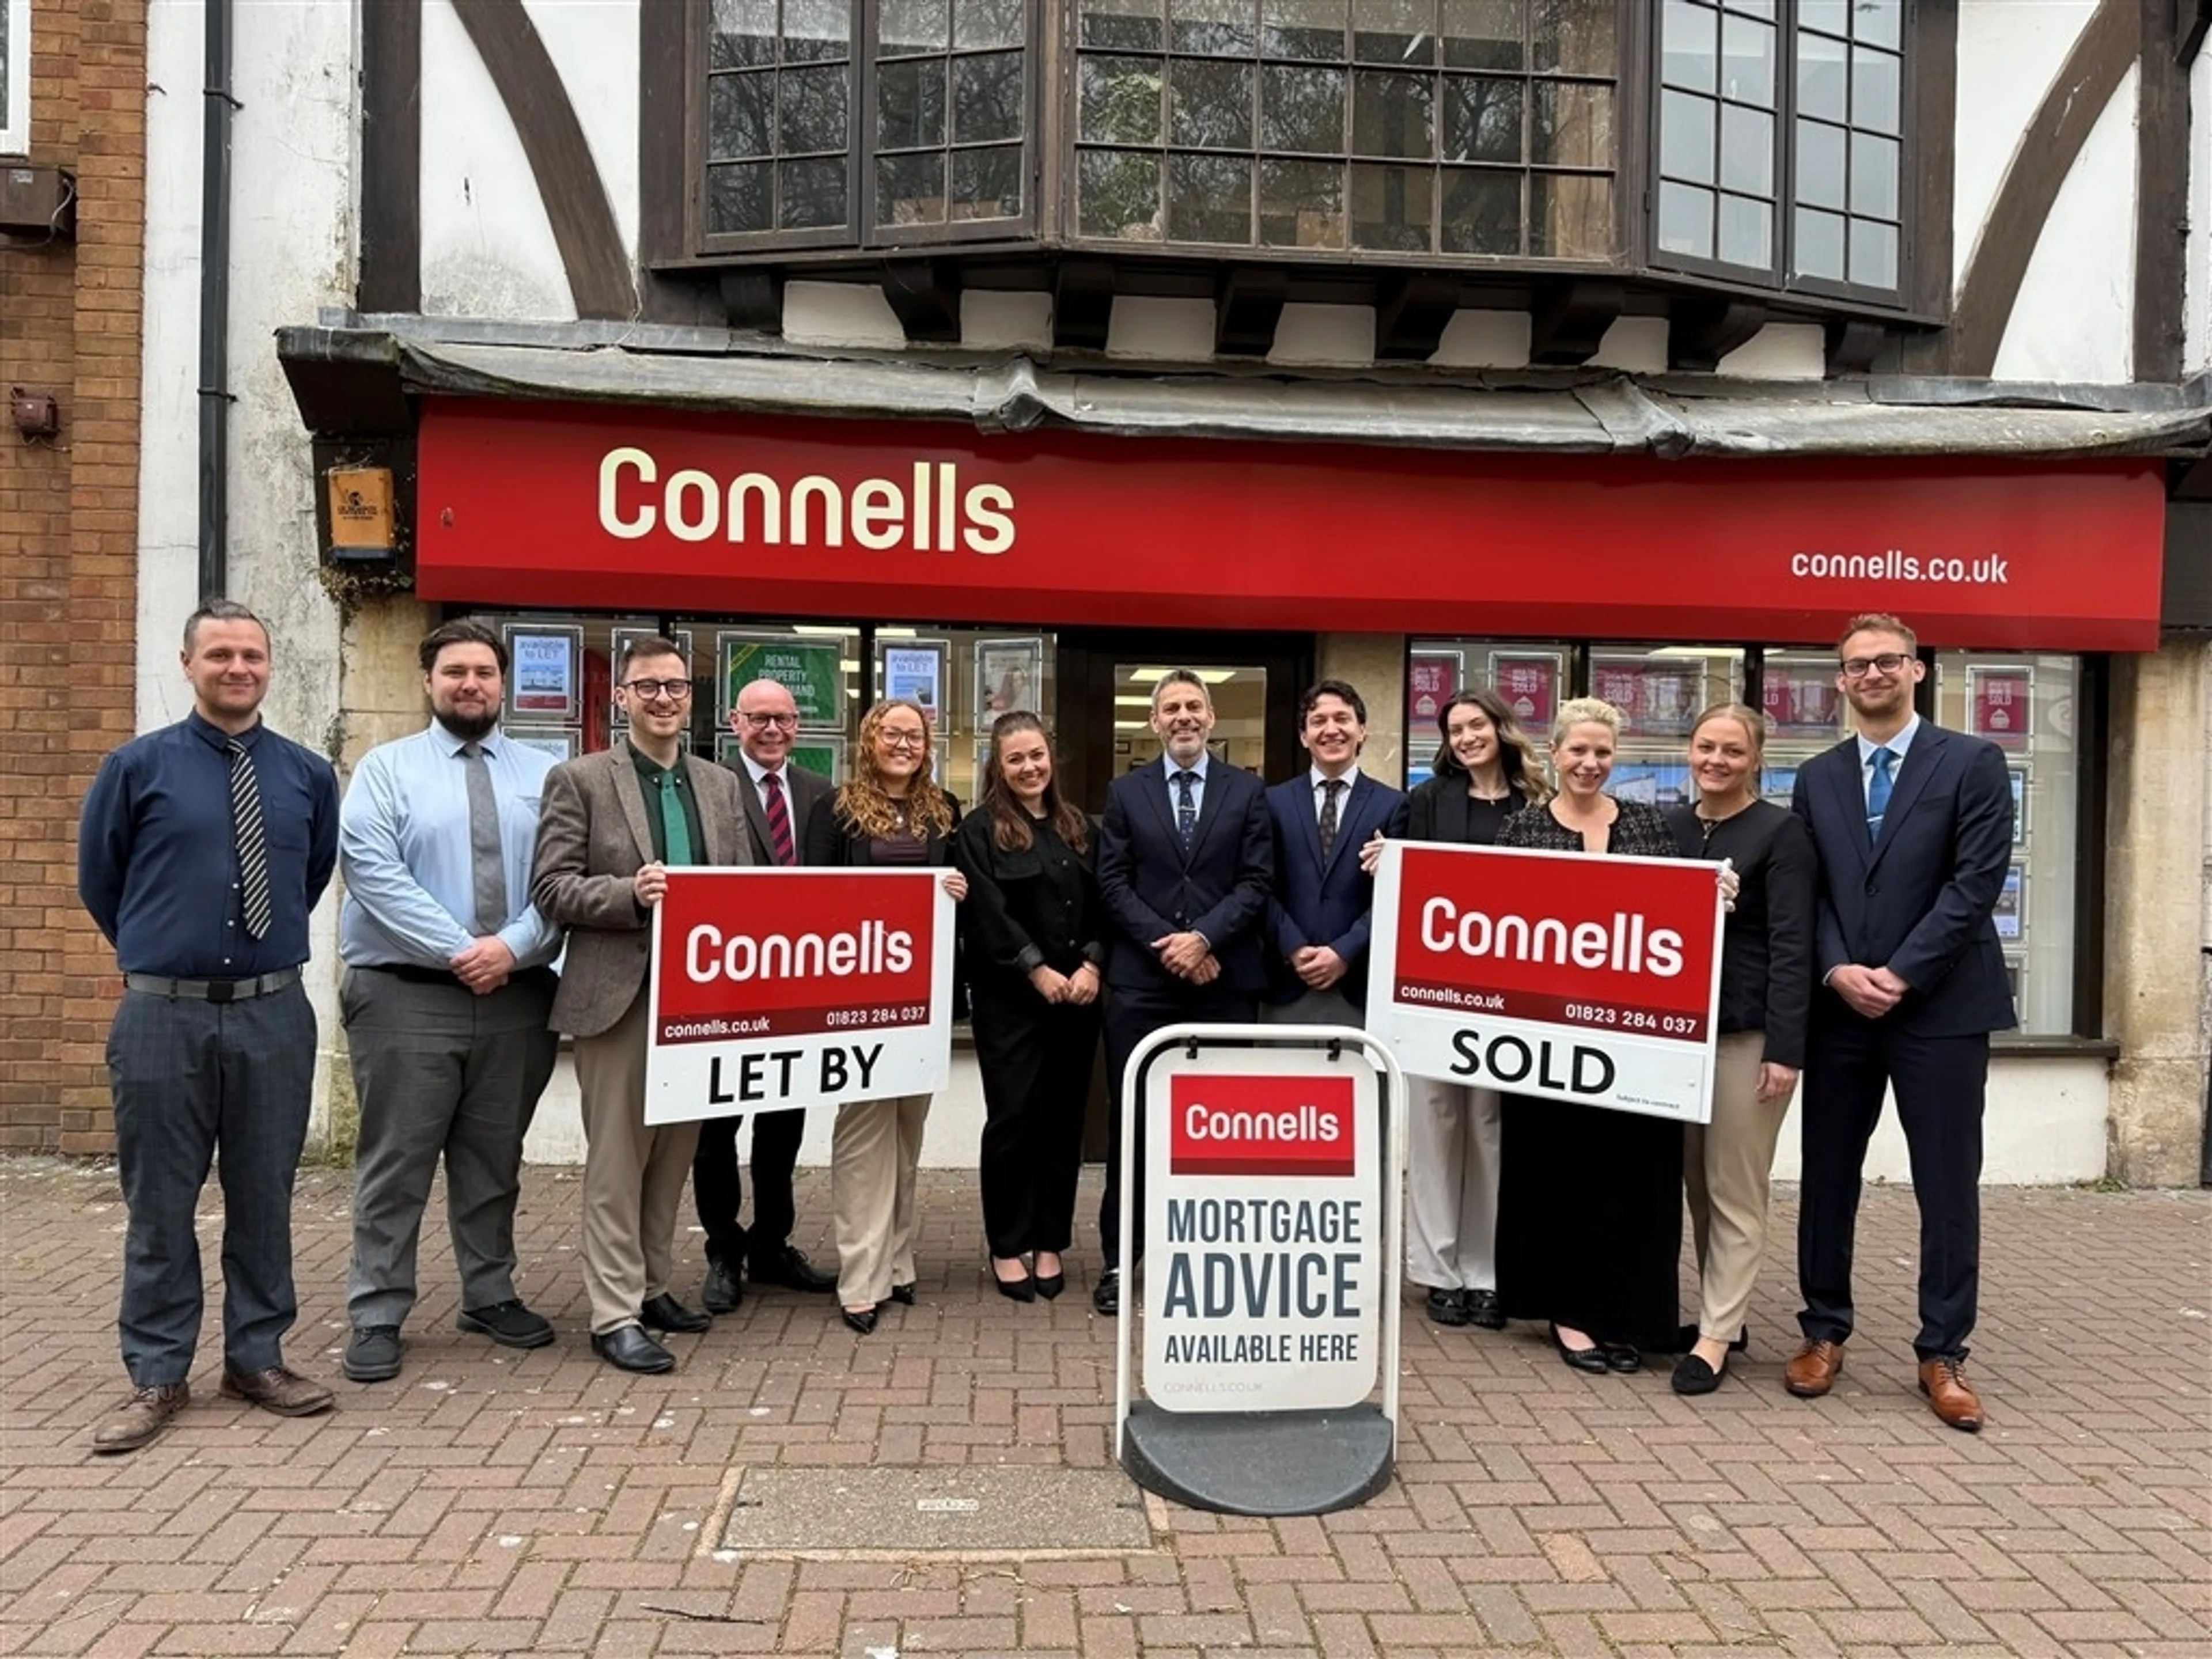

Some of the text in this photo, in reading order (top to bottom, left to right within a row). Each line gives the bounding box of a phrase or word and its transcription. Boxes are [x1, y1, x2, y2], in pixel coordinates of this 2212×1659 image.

[599, 446, 1016, 555] Connells
[1791, 550, 2008, 584] connells.co.uk
[520, 639, 565, 649] available
[764, 654, 800, 668] RENTAL
[891, 652, 934, 662] available
[758, 668, 806, 682] PROPERTY
[685, 920, 913, 983] Connells
[1420, 896, 1684, 977] Connells
[665, 1006, 926, 1038] connells.co.uk 01823 284 037
[1401, 984, 1697, 1034] connells.co.uk 01823 284 037
[709, 1043, 885, 1105] LET BY
[1449, 1029, 1616, 1095] SOLD
[1185, 1103, 1340, 1142] Connells
[1167, 1199, 1362, 1244] MORTGAGE
[1163, 1252, 1361, 1319] ADVICE
[1164, 1334, 1358, 1365] AVAILABLE HERE
